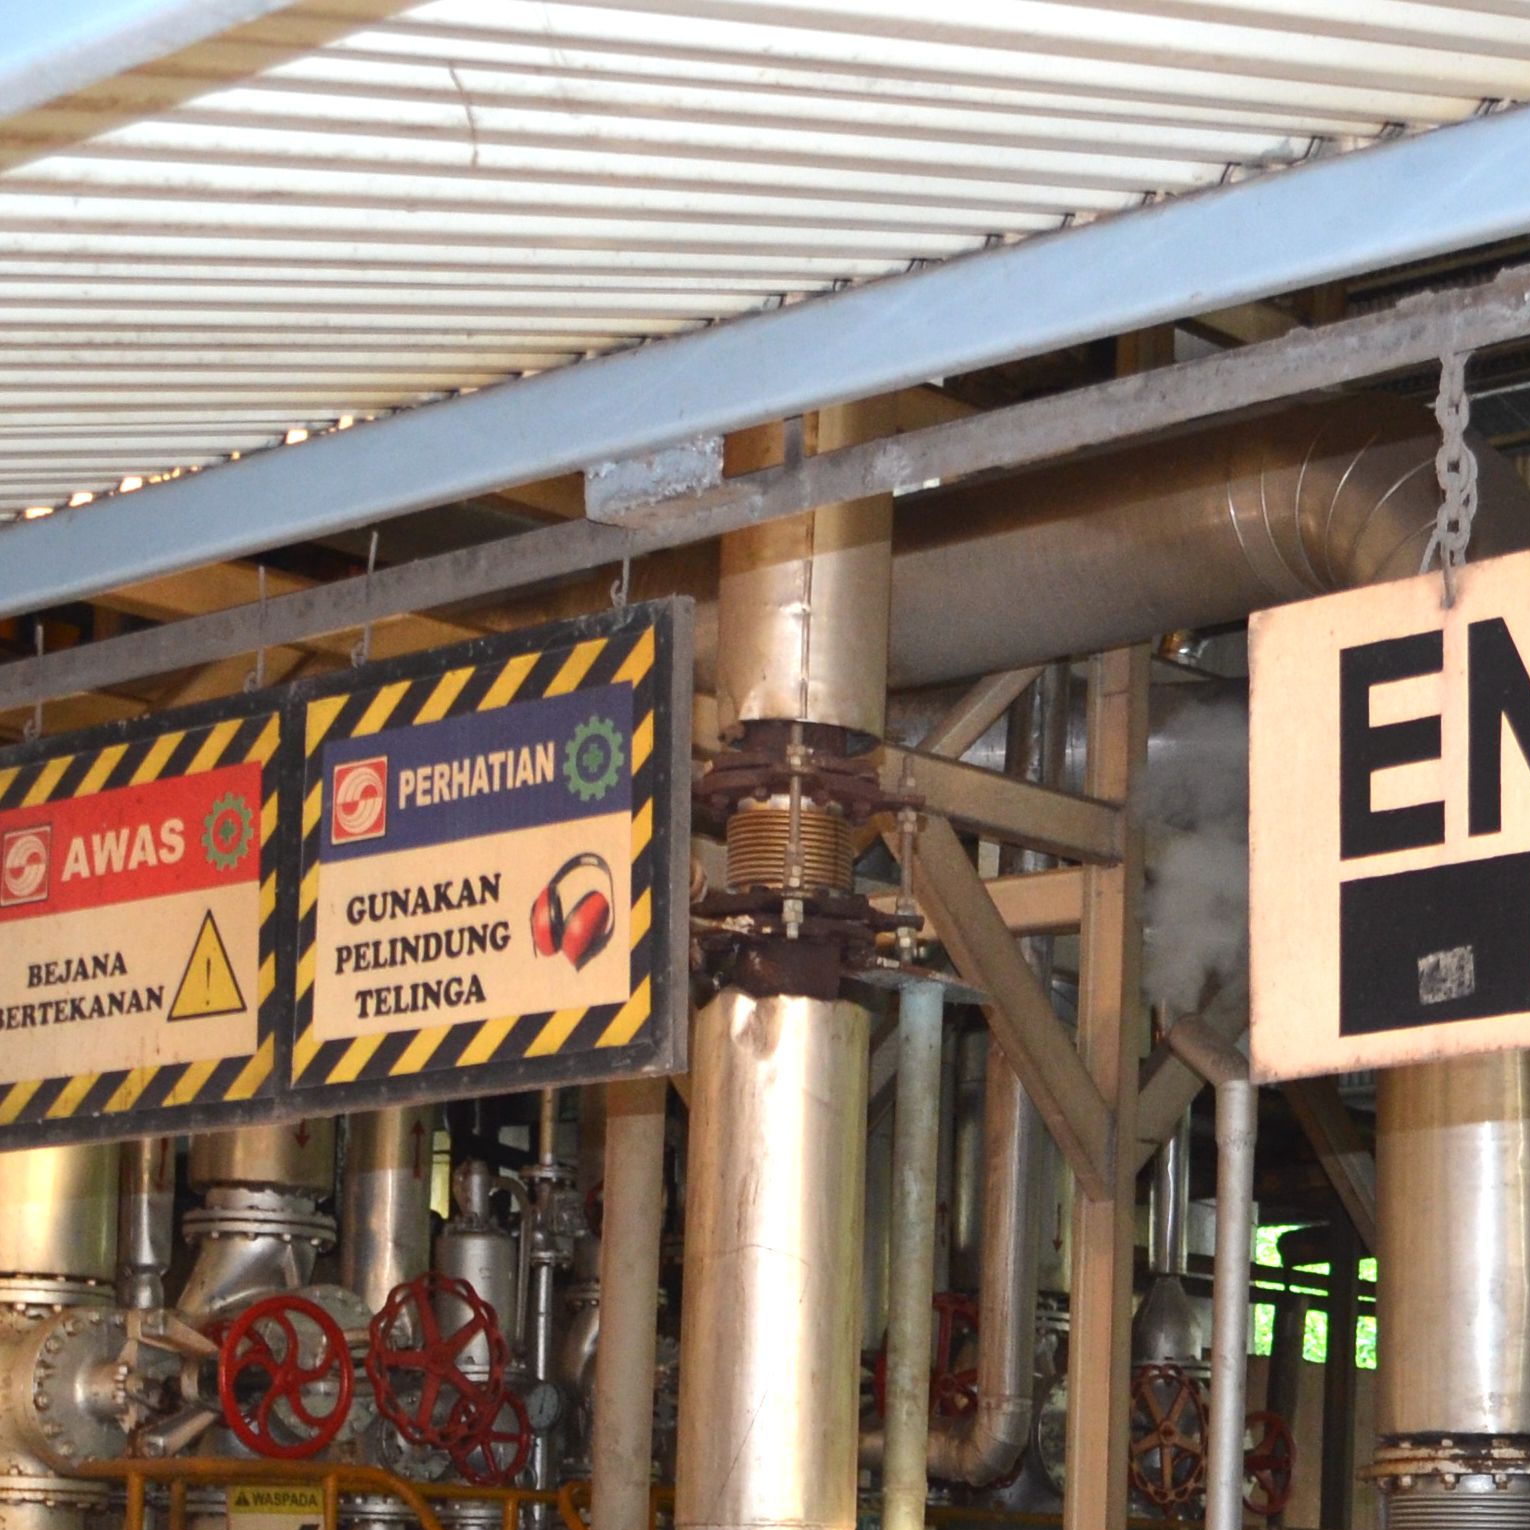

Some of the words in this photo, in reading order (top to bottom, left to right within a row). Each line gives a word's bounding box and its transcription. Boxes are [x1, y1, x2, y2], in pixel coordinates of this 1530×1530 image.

[397, 741, 556, 810] PERHATIAN
[60, 818, 186, 882] AWAS
[346, 873, 502, 926] GUNAKAN
[27, 951, 128, 988] BEJANA
[334, 921, 512, 976] PELINDUNG
[355, 974, 486, 1019] TELINGA
[252, 1492, 318, 1507] WASPADA
